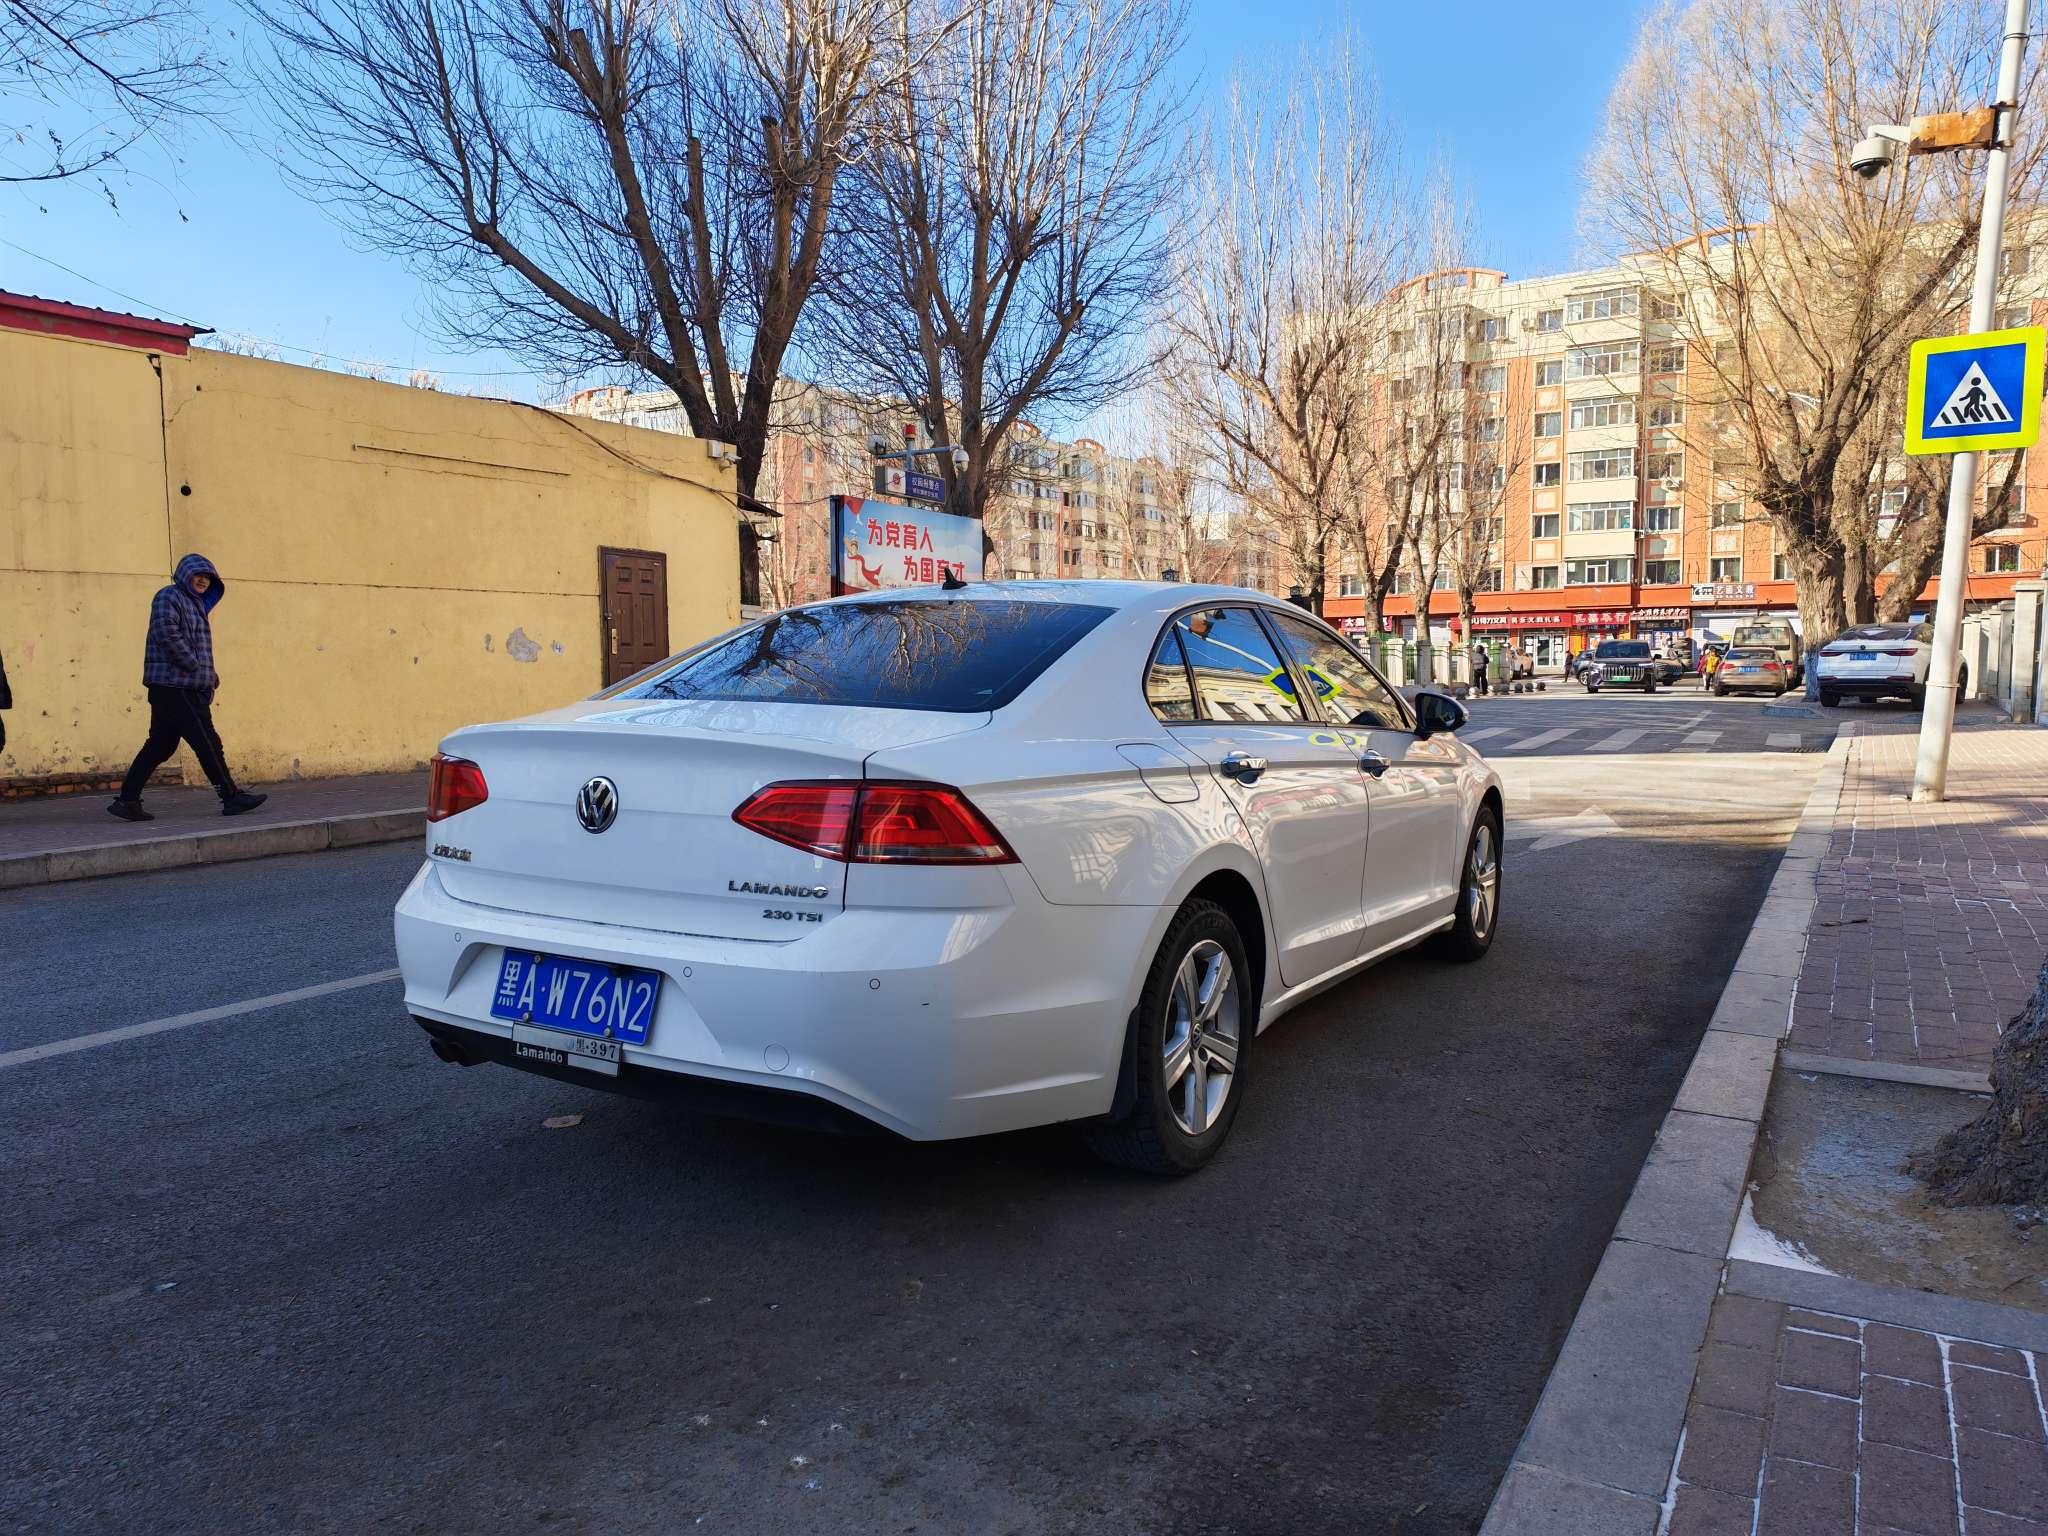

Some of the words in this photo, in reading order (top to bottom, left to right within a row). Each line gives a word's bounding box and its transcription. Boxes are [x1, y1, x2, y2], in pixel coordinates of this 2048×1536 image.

[867, 517, 934, 552] 为党育人
[903, 555, 966, 583] 为国育才
[728, 880, 830, 899] LAMANDO
[762, 909, 792, 921] 230
[794, 911, 823, 923] TSI
[516, 1043, 563, 1064] Lamando
